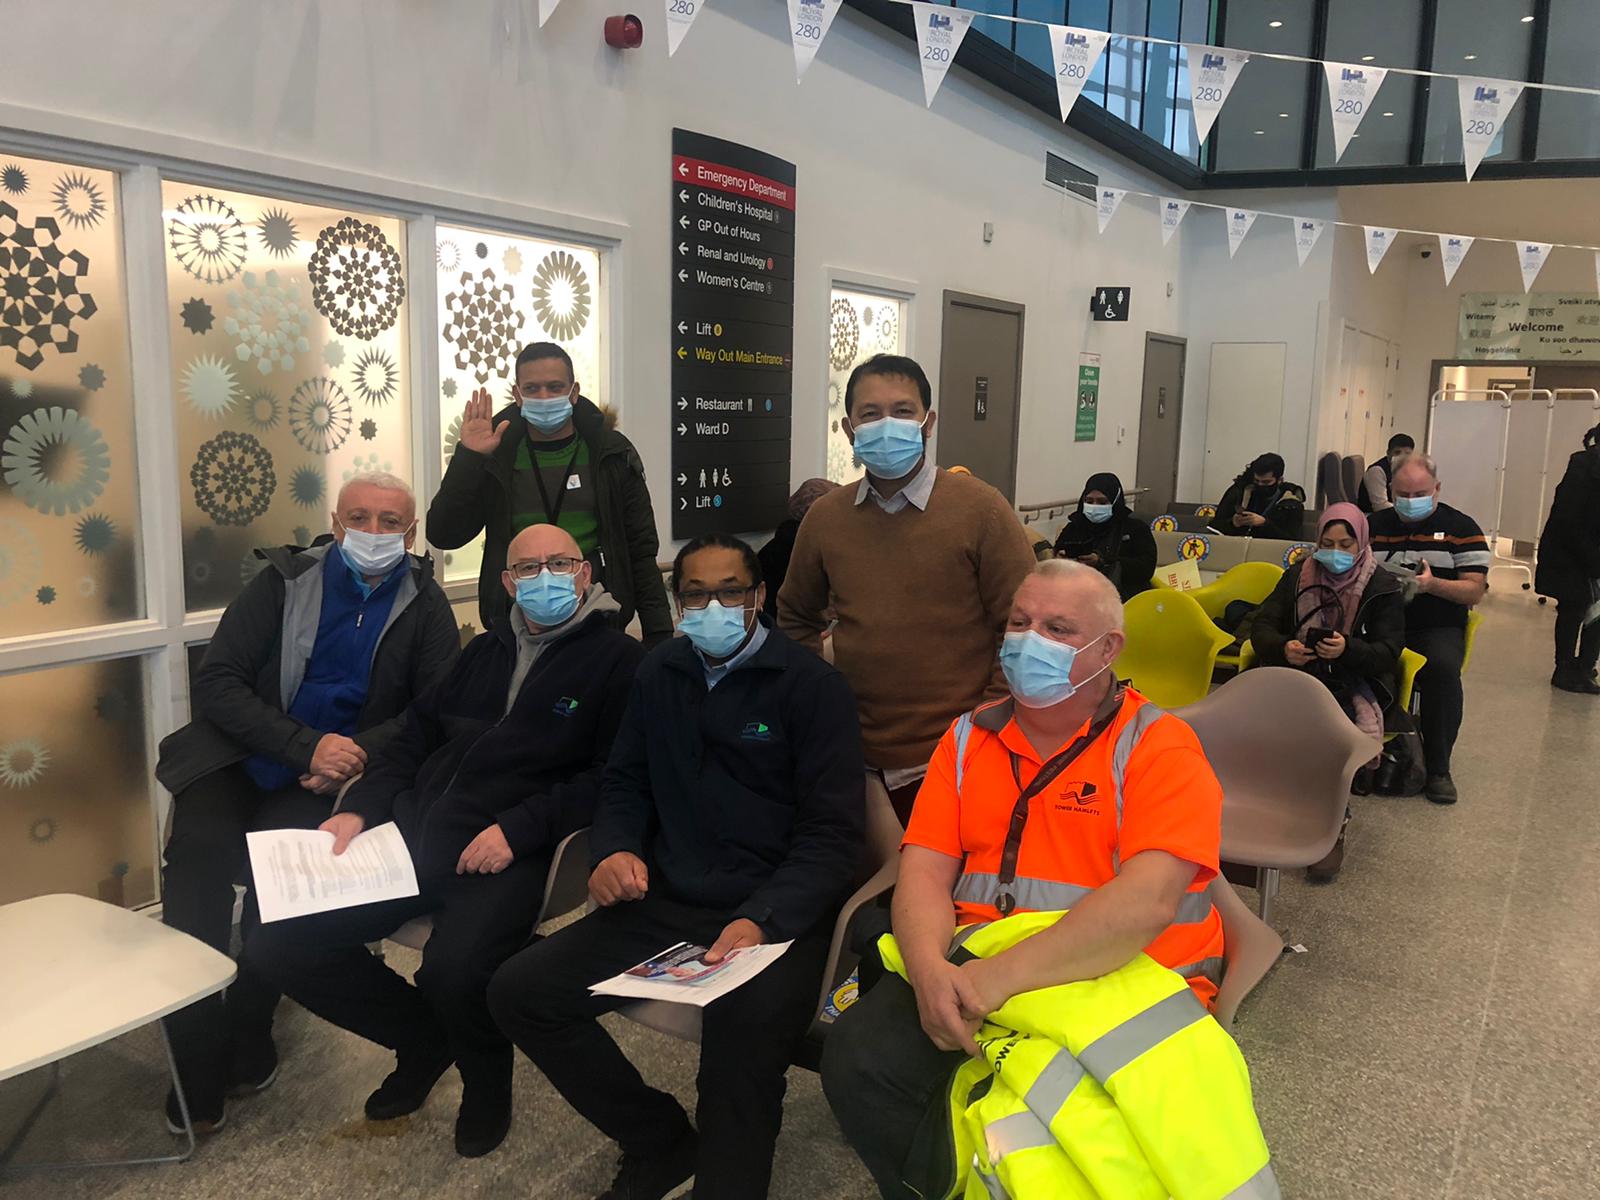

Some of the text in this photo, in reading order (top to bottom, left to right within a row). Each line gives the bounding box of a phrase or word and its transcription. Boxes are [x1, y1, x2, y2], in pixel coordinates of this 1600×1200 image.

[669, 0, 695, 15] 280
[795, 23, 821, 40] 280
[924, 46, 950, 62] 280
[1059, 62, 1086, 79] 280
[1195, 86, 1222, 102] 280
[1335, 99, 1363, 115] 280
[1466, 119, 1495, 136] 280
[697, 166, 787, 202] Emergency Department
[697, 192, 743, 213] Children's
[744, 202, 774, 222] Hospital
[697, 218, 761, 242] GP Out of Hours
[697, 244, 767, 271] Renal and Urology
[696, 269, 739, 289] Women's
[740, 276, 765, 293] Centre
[1465, 312, 1497, 322] Witamy
[696, 321, 712, 336] Lift
[1508, 322, 1565, 332] Welcome
[695, 347, 784, 365] Way Out Main Entrance
[695, 397, 743, 411] Restaurant
[695, 422, 730, 436] Ward D
[695, 495, 711, 508] Lift
[1073, 807, 1100, 816] HAMLETS
